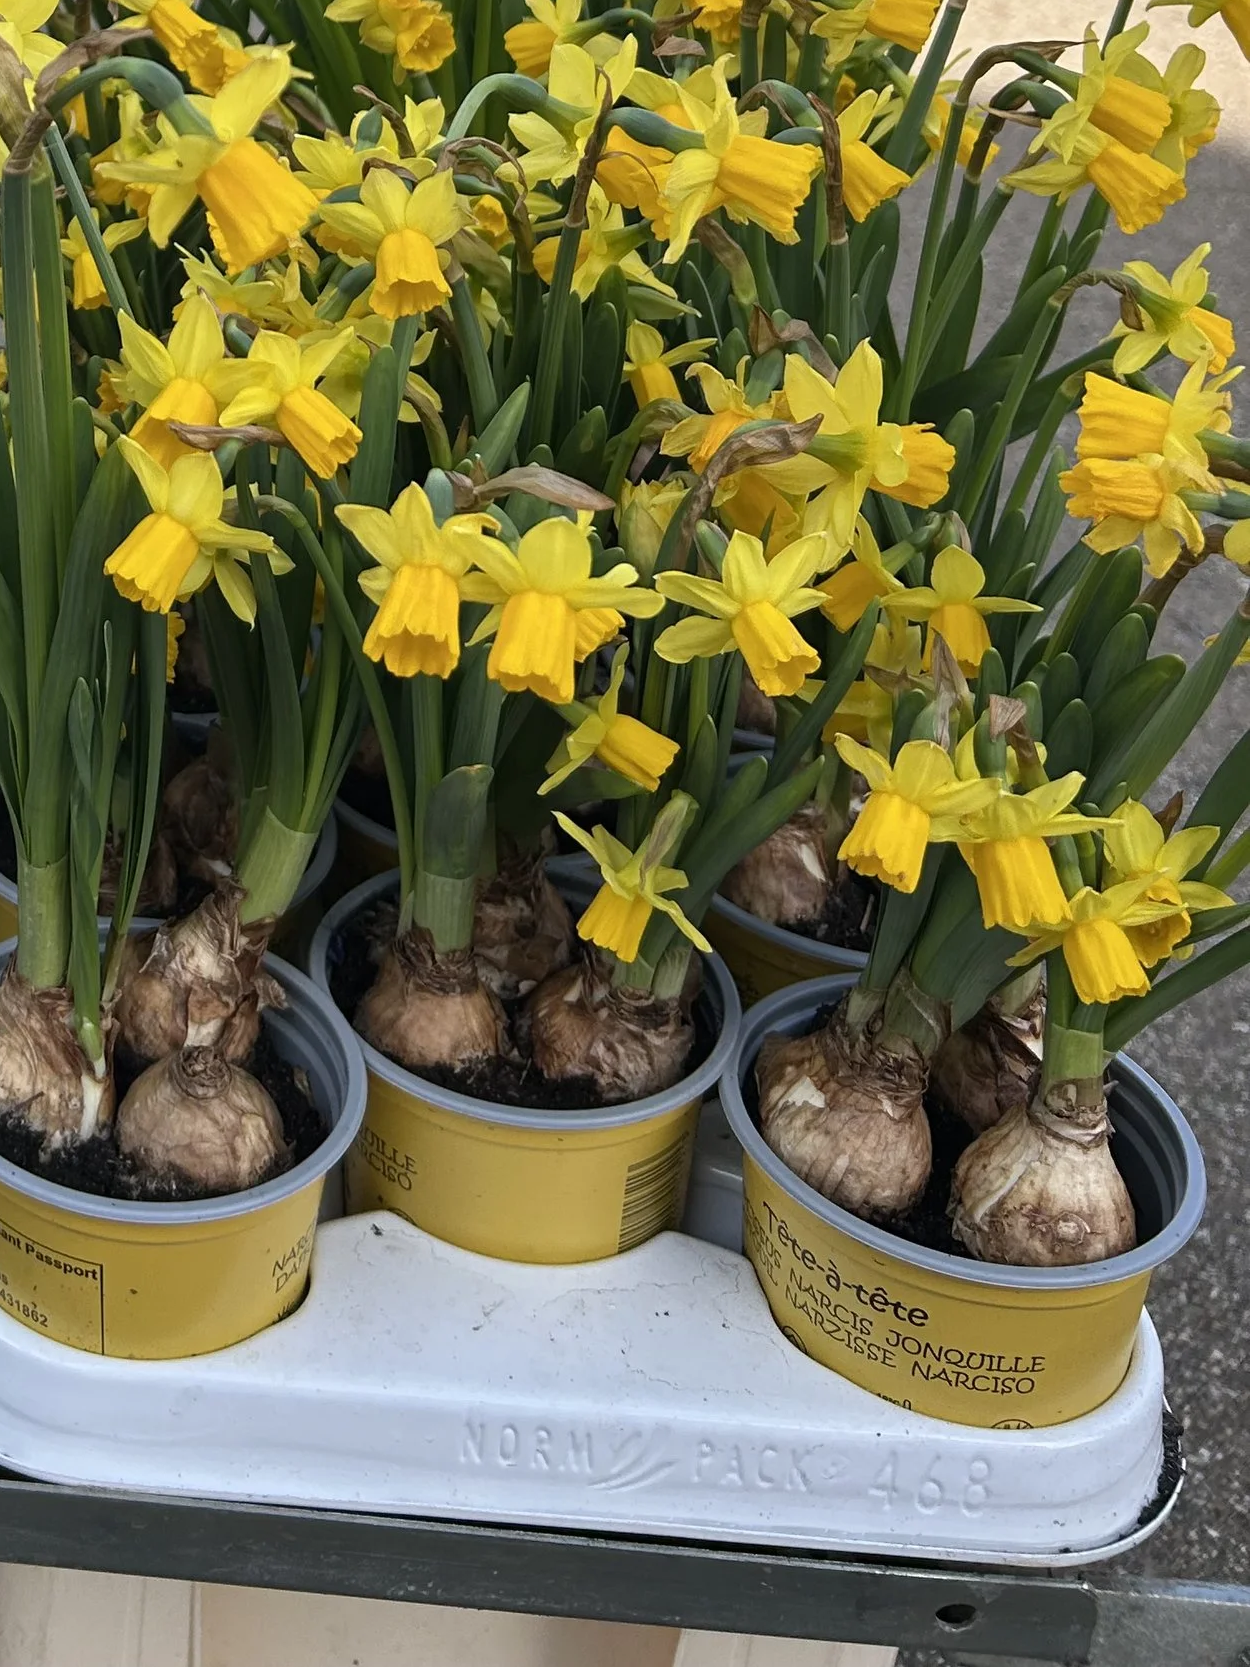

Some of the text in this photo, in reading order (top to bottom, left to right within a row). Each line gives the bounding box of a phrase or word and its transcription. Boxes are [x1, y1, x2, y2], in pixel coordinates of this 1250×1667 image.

[24, 1241, 98, 1281] Passport
[784, 1283, 898, 1369] NARZISSE
[911, 1360, 1035, 1395] NARCISO
[789, 1266, 873, 1337] NARCIS
[885, 1329, 1046, 1374] JONQUILLE
[458, 1420, 595, 1475] NORM
[866, 1448, 993, 1520] 468
